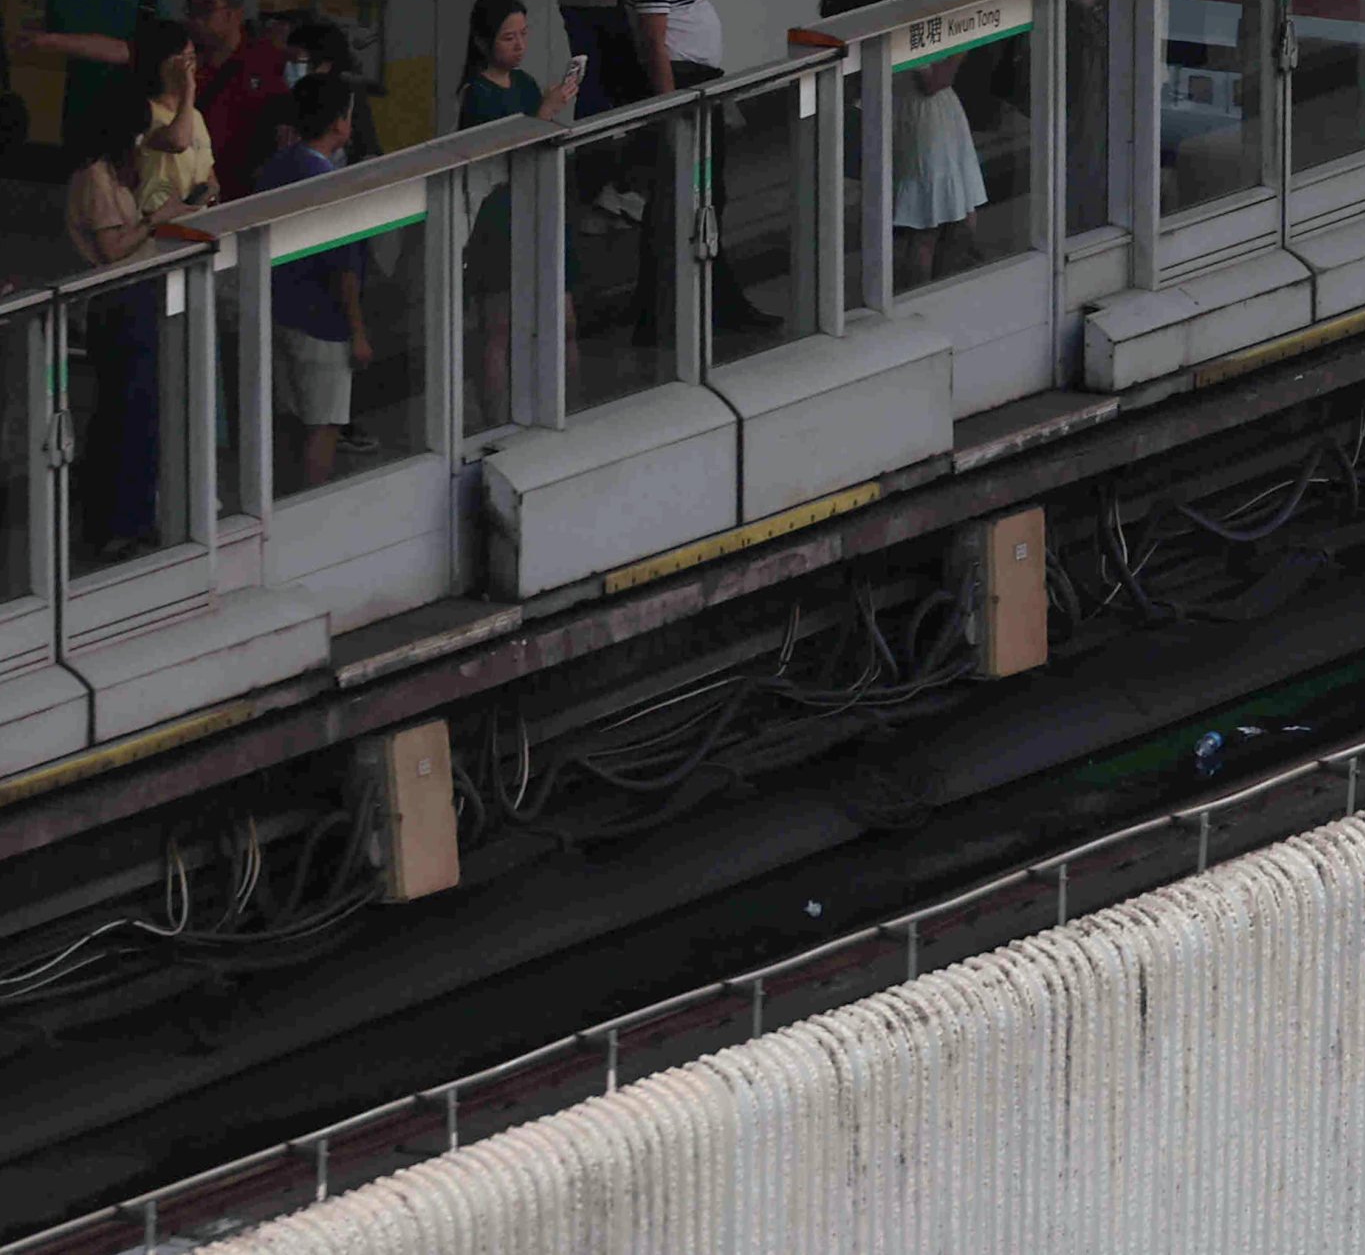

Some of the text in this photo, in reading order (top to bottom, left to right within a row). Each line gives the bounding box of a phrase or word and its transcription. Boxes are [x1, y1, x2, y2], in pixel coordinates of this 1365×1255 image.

[909, 8, 1001, 51] 觀塘 Kwun Tong
